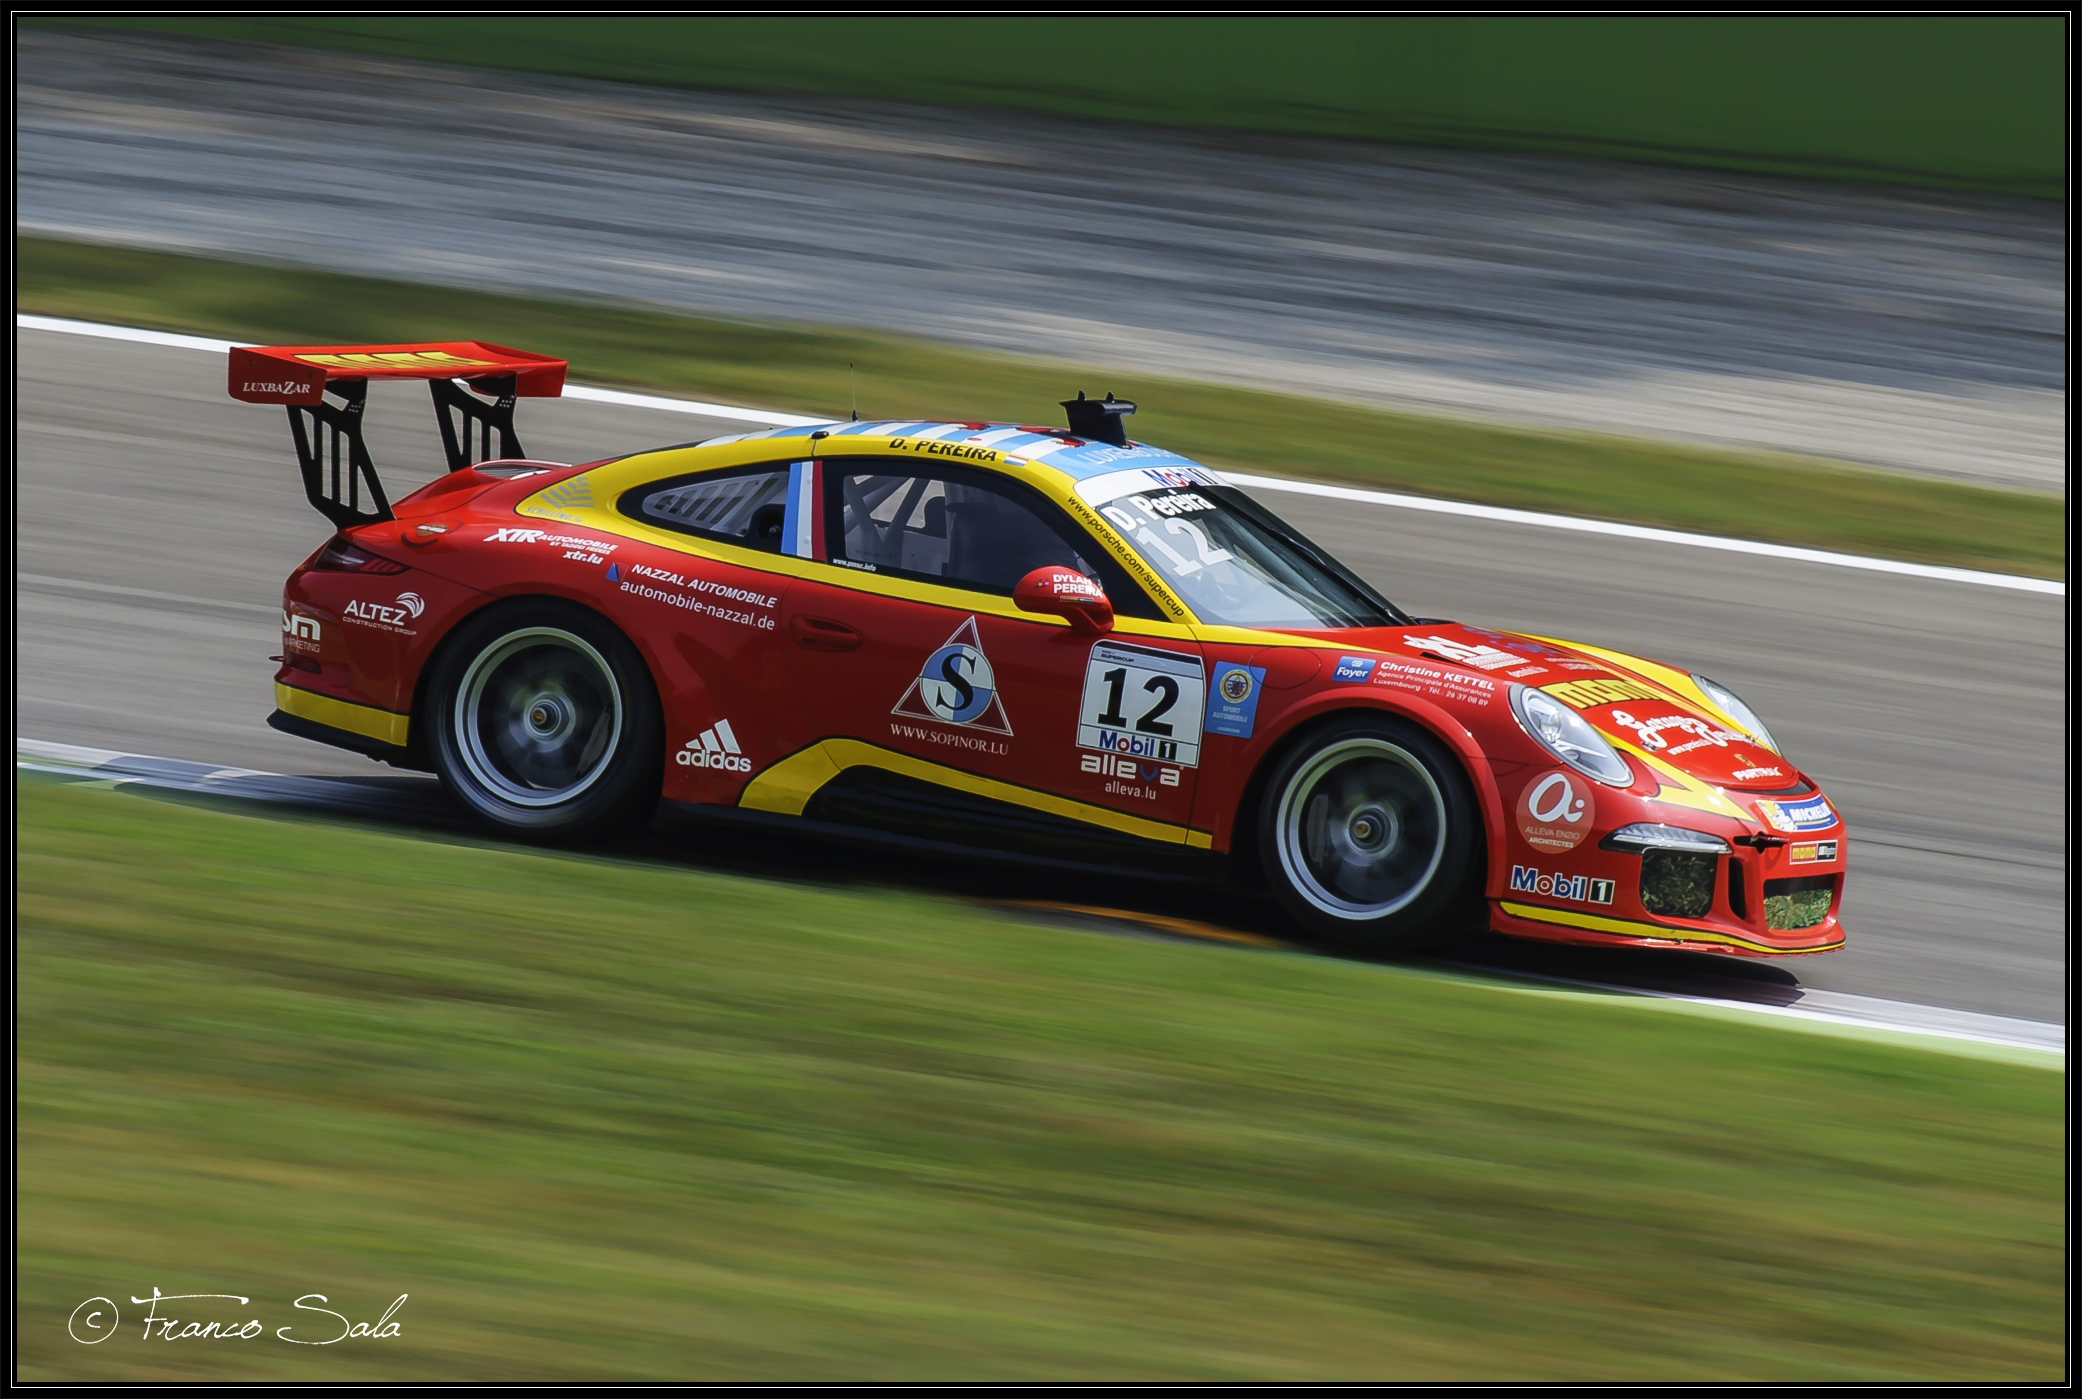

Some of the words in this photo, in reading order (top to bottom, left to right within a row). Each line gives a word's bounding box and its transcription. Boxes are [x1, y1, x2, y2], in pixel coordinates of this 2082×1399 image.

[889, 438, 908, 451] D.
[914, 440, 998, 462] PEREIRA
[1100, 506, 1148, 532] D.
[1127, 489, 1217, 521] Pereira
[482, 528, 544, 544] XTR
[537, 534, 619, 552] AUTOMOBILE
[1135, 517, 1234, 577] 12
[562, 550, 605, 565] xtr.lu
[1067, 496, 1185, 617] www.porsche.com/supercup
[631, 564, 685, 586] NAZZAL
[687, 579, 778, 608] AUTOMOBILE
[1053, 573, 1093, 586] DYLAN
[1053, 583, 1104, 599] PEREIRA
[343, 599, 408, 626] ALTEZ
[620, 581, 776, 631] automobile-nazzal.de
[342, 616, 393, 631] CONSTRUCTION
[394, 627, 417, 636] GROUP
[935, 652, 977, 712] S
[1337, 666, 1369, 679] Foyer
[1377, 671, 1405, 680] Agence
[1405, 675, 1443, 687] Principale
[1380, 661, 1441, 679] Christine
[1443, 672, 1495, 691] KETTEL
[1097, 667, 1180, 738] 12
[1373, 678, 1422, 692] Luxembourg
[1445, 690, 1456, 699] 26
[1456, 693, 1467, 702] 37
[890, 723, 1009, 756] WWW.SOPINOR.LU
[1099, 729, 1156, 758] Mobil
[675, 749, 752, 772] adidas
[1080, 753, 1180, 787] alleva
[1105, 780, 1157, 801] alleva.lu
[1525, 826, 1555, 837] ALLEVA
[1556, 829, 1581, 840] ENZIO
[1528, 836, 1575, 849] ARCHITECTES
[1510, 865, 1588, 901] Mobil
